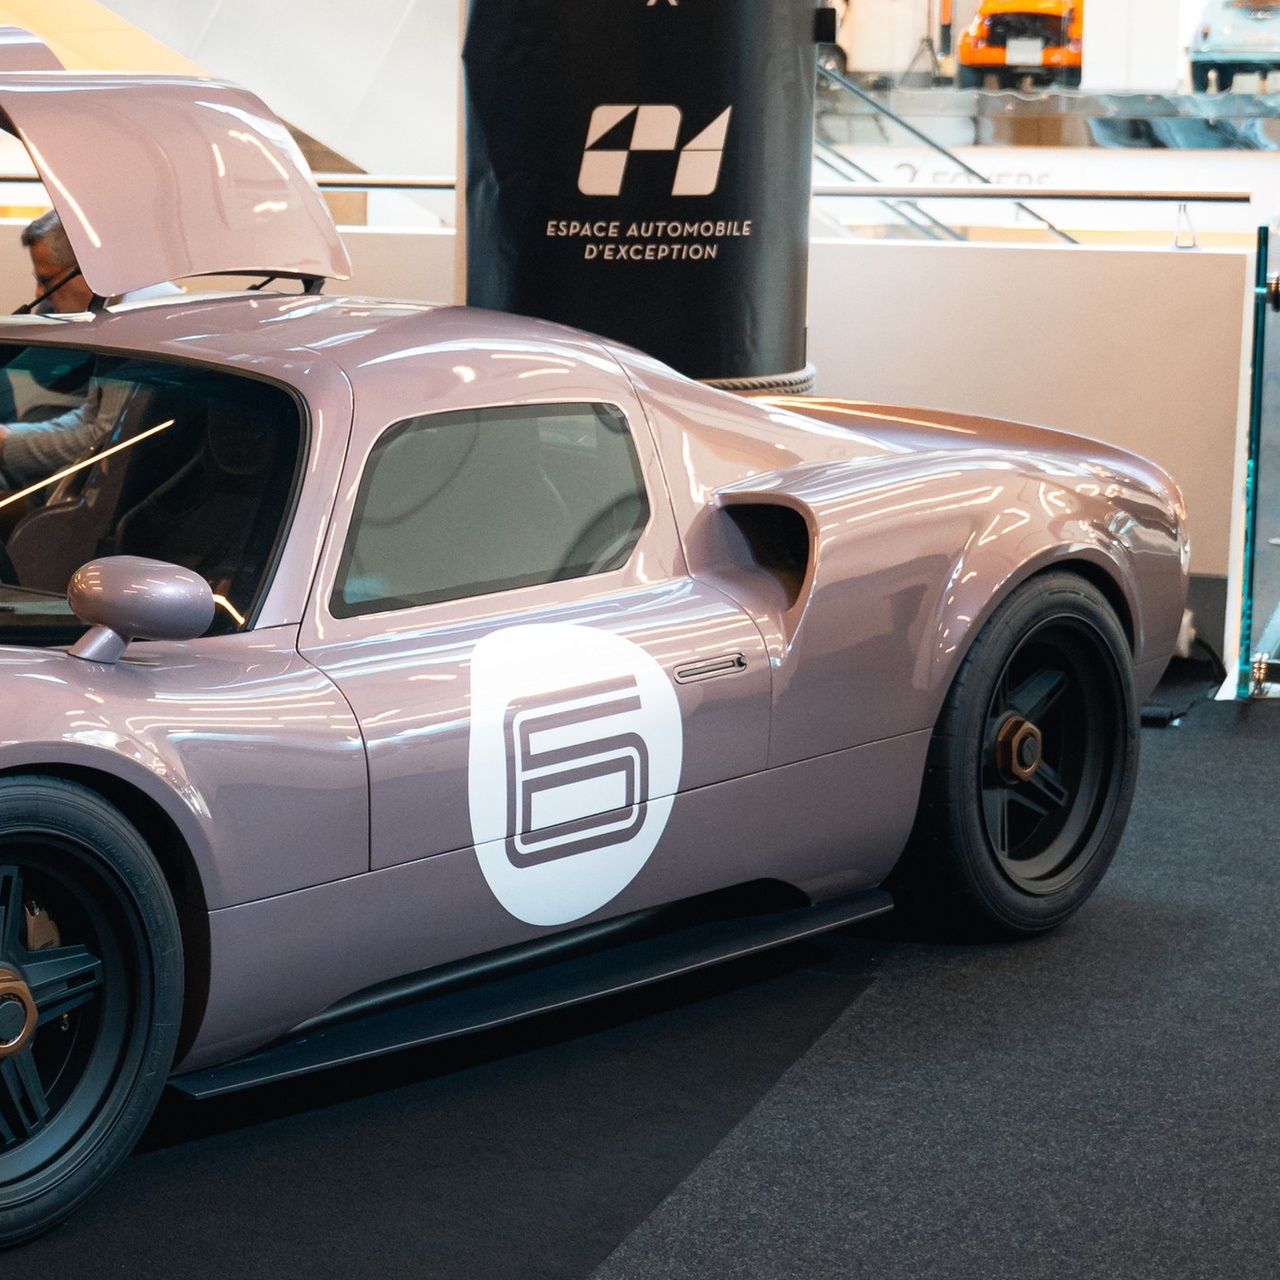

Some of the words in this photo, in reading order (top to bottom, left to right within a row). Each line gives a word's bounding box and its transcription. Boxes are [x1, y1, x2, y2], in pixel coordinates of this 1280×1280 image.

[546, 220, 620, 237] ESPACE
[625, 220, 753, 237] AUTOMOBILE
[583, 243, 719, 261] D'EXCEPTION
[502, 673, 650, 870] 6
